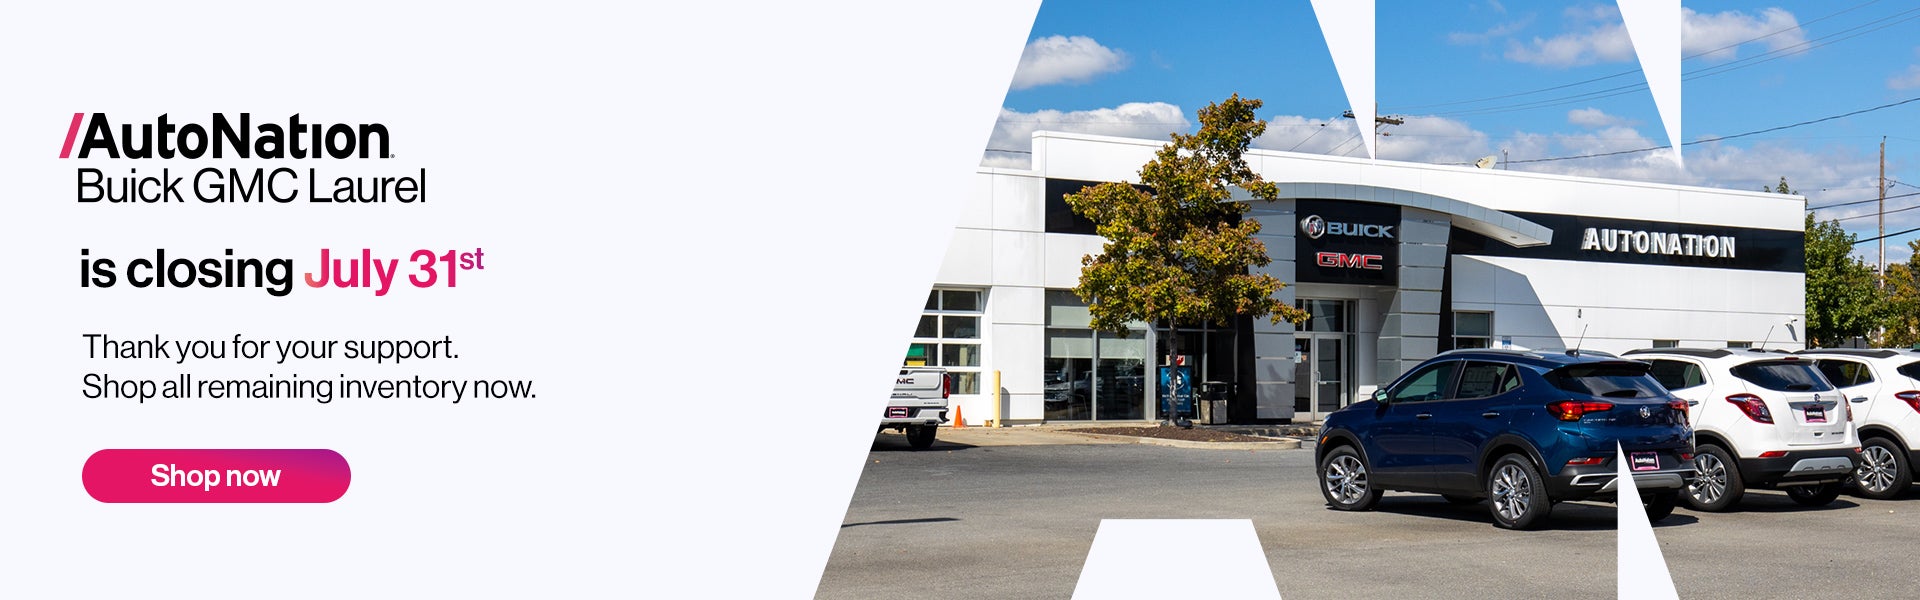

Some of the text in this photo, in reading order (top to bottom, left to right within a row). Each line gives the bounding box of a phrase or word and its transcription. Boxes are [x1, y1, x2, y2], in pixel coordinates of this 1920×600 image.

[1327, 221, 1394, 238] BUICK
[1581, 227, 1735, 258] AUTONATION
[1317, 251, 1383, 270] GMC
